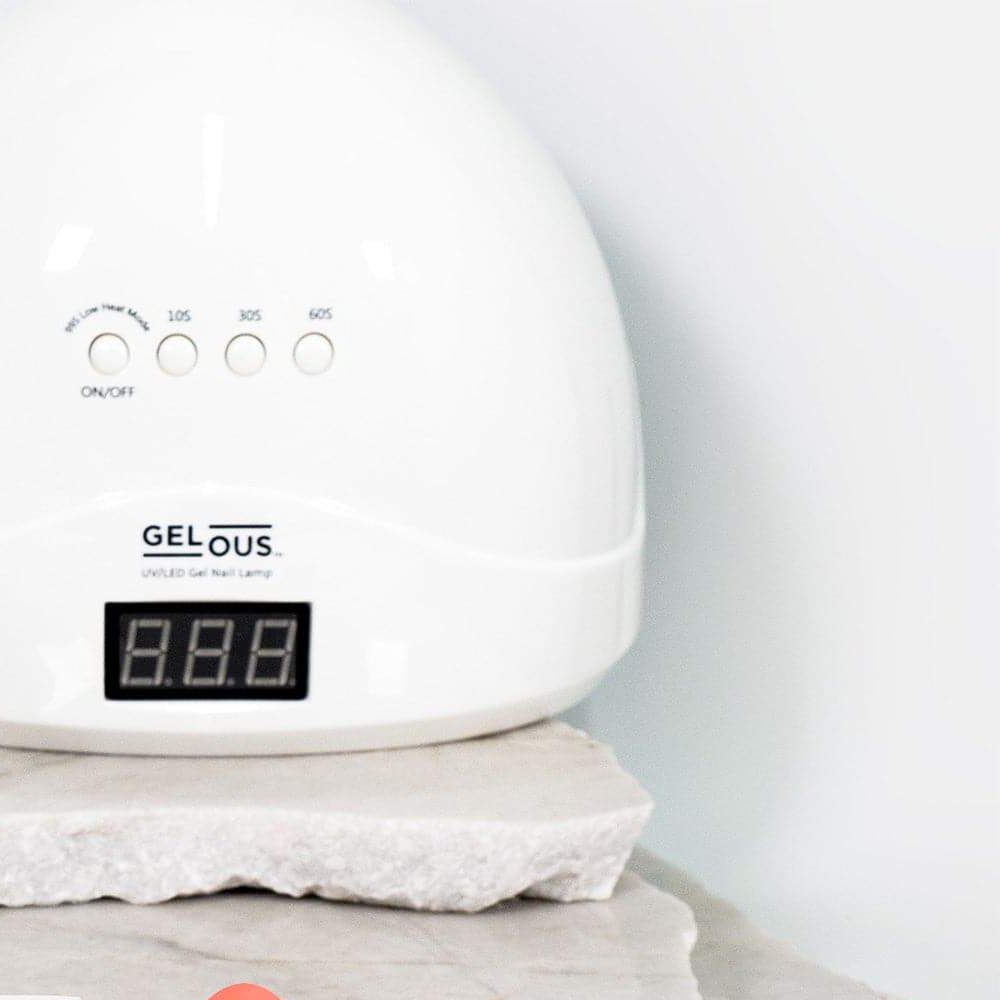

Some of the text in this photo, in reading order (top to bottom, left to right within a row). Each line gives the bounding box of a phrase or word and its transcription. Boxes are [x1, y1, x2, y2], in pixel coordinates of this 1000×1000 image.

[167, 309, 192, 322] 10S
[238, 309, 263, 322] 30S
[308, 307, 333, 320] 60S
[80, 385, 135, 399] ON/OFF
[141, 567, 273, 580] UV/LED Gel Nail Lamp
